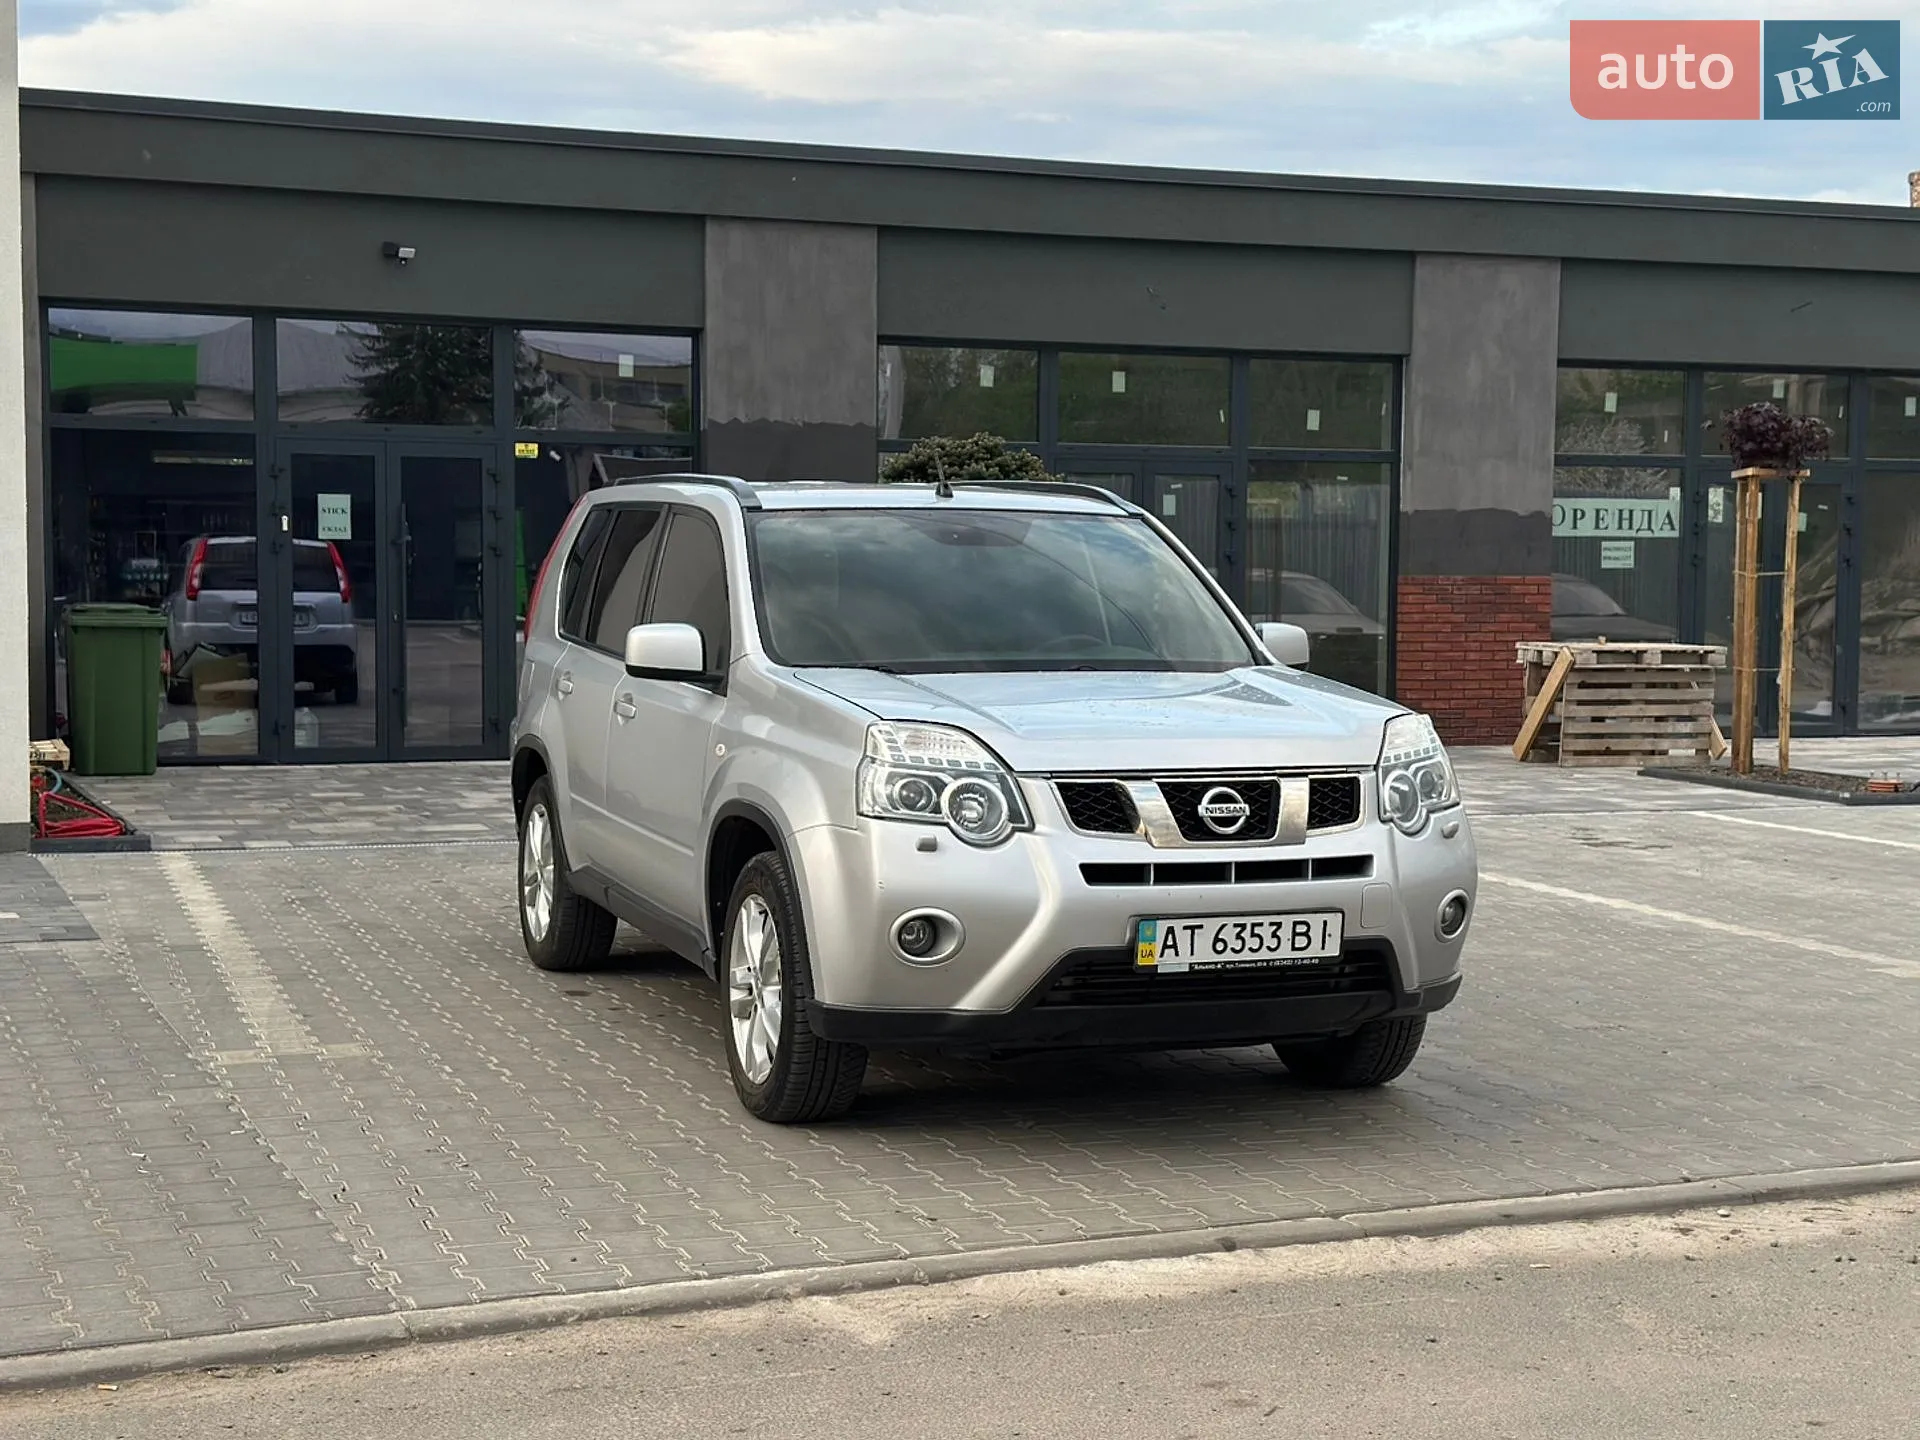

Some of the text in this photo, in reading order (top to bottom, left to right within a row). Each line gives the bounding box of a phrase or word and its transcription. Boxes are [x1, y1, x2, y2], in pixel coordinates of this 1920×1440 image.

[1551, 503, 1677, 535] ОРЕНДА
[1204, 806, 1247, 815] NISSAN
[1159, 919, 1328, 958] AT 6353 BI
[1140, 950, 1155, 959] UA
